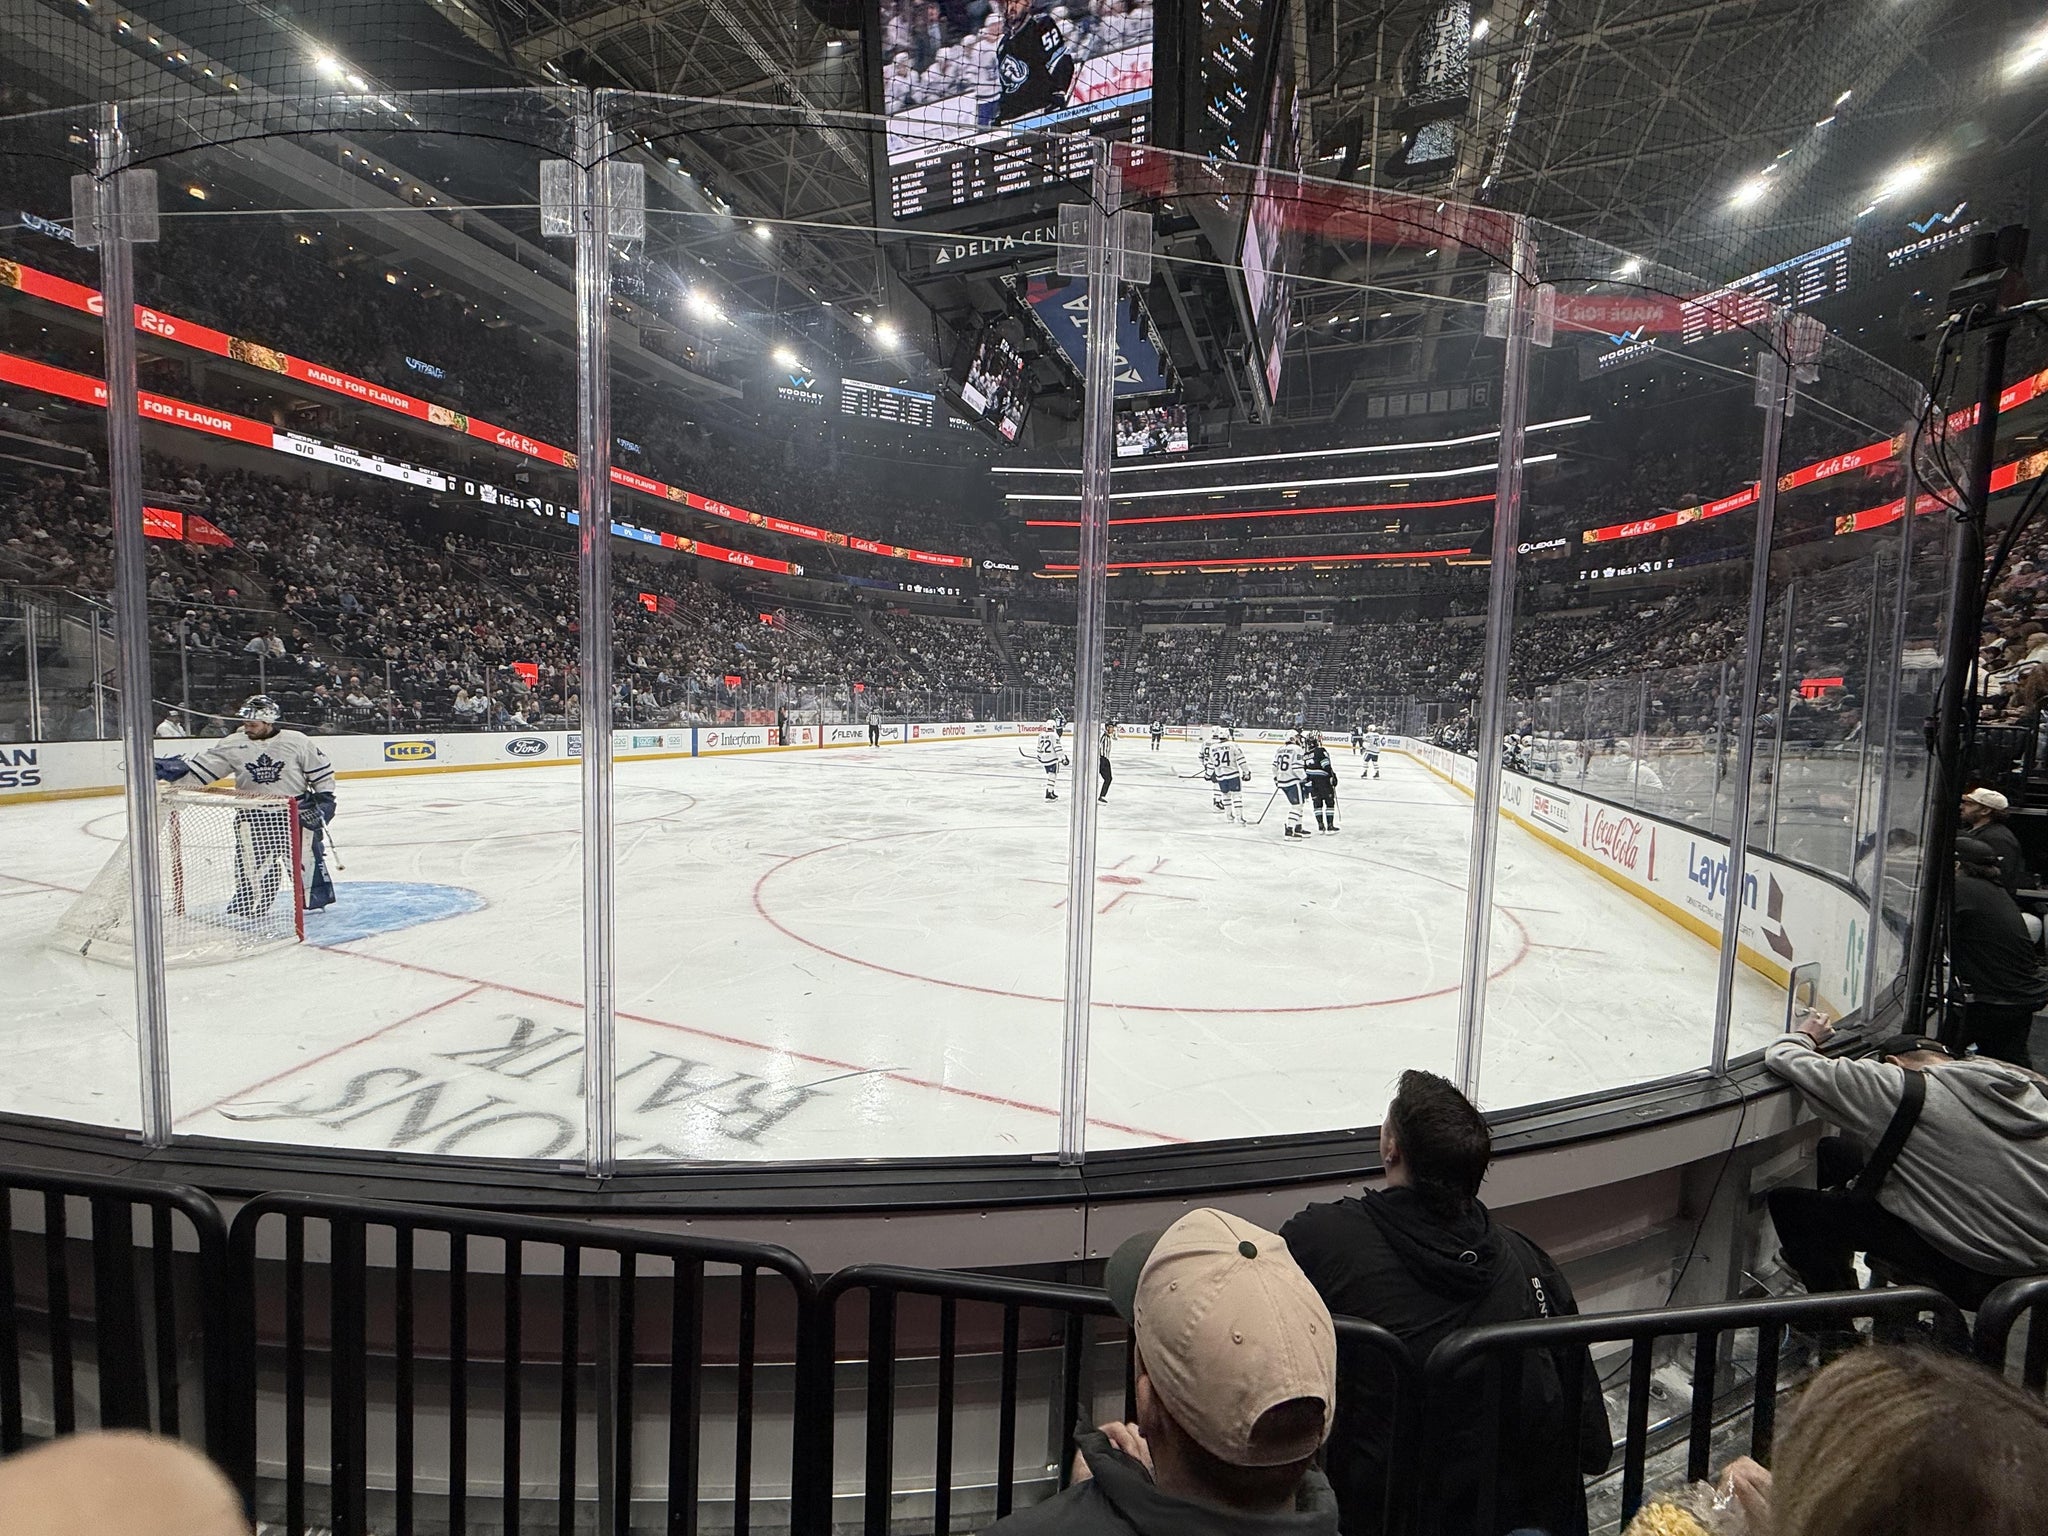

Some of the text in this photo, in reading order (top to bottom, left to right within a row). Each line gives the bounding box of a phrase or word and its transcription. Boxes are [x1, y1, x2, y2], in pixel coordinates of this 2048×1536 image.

[1041, 28, 1060, 51] 52
[955, 234, 1015, 260] DELTA
[1598, 337, 1657, 363] WOODLEY
[405, 355, 447, 379] UTAH
[307, 368, 409, 409] MADE FOR FLAVOR
[778, 386, 824, 401] WOODLEY
[143, 398, 233, 432] FOR FLAVOR
[521, 438, 538, 455] Rio
[295, 443, 432, 485] 0/0 100% 0 0 2
[1842, 454, 1861, 471] Rio
[622, 474, 635, 485] FOR
[635, 478, 657, 491] FLAVOR
[464, 481, 475, 496] 0
[499, 494, 525, 510] 16:51
[545, 503, 554, 516] 0
[800, 527, 818, 538] FLAVOR
[1530, 537, 1567, 550] LEXUS
[993, 563, 1020, 571] LEXUS
[1590, 569, 1599, 579] 0
[1654, 561, 1661, 570] 0
[837, 730, 863, 739] FILEVINE
[920, 727, 935, 735] TOYOTA
[942, 724, 966, 736] entrata
[1322, 734, 1349, 743] assword
[512, 739, 542, 753] Ford
[721, 731, 761, 748] Interform
[390, 746, 432, 756] IKEA
[1213, 750, 1231, 767] 34
[1534, 795, 1567, 820] SME STEEL
[1591, 808, 1643, 870] Coca-Cola
[1688, 841, 1758, 911] Laytn
[1531, 1277, 1549, 1319] SON
